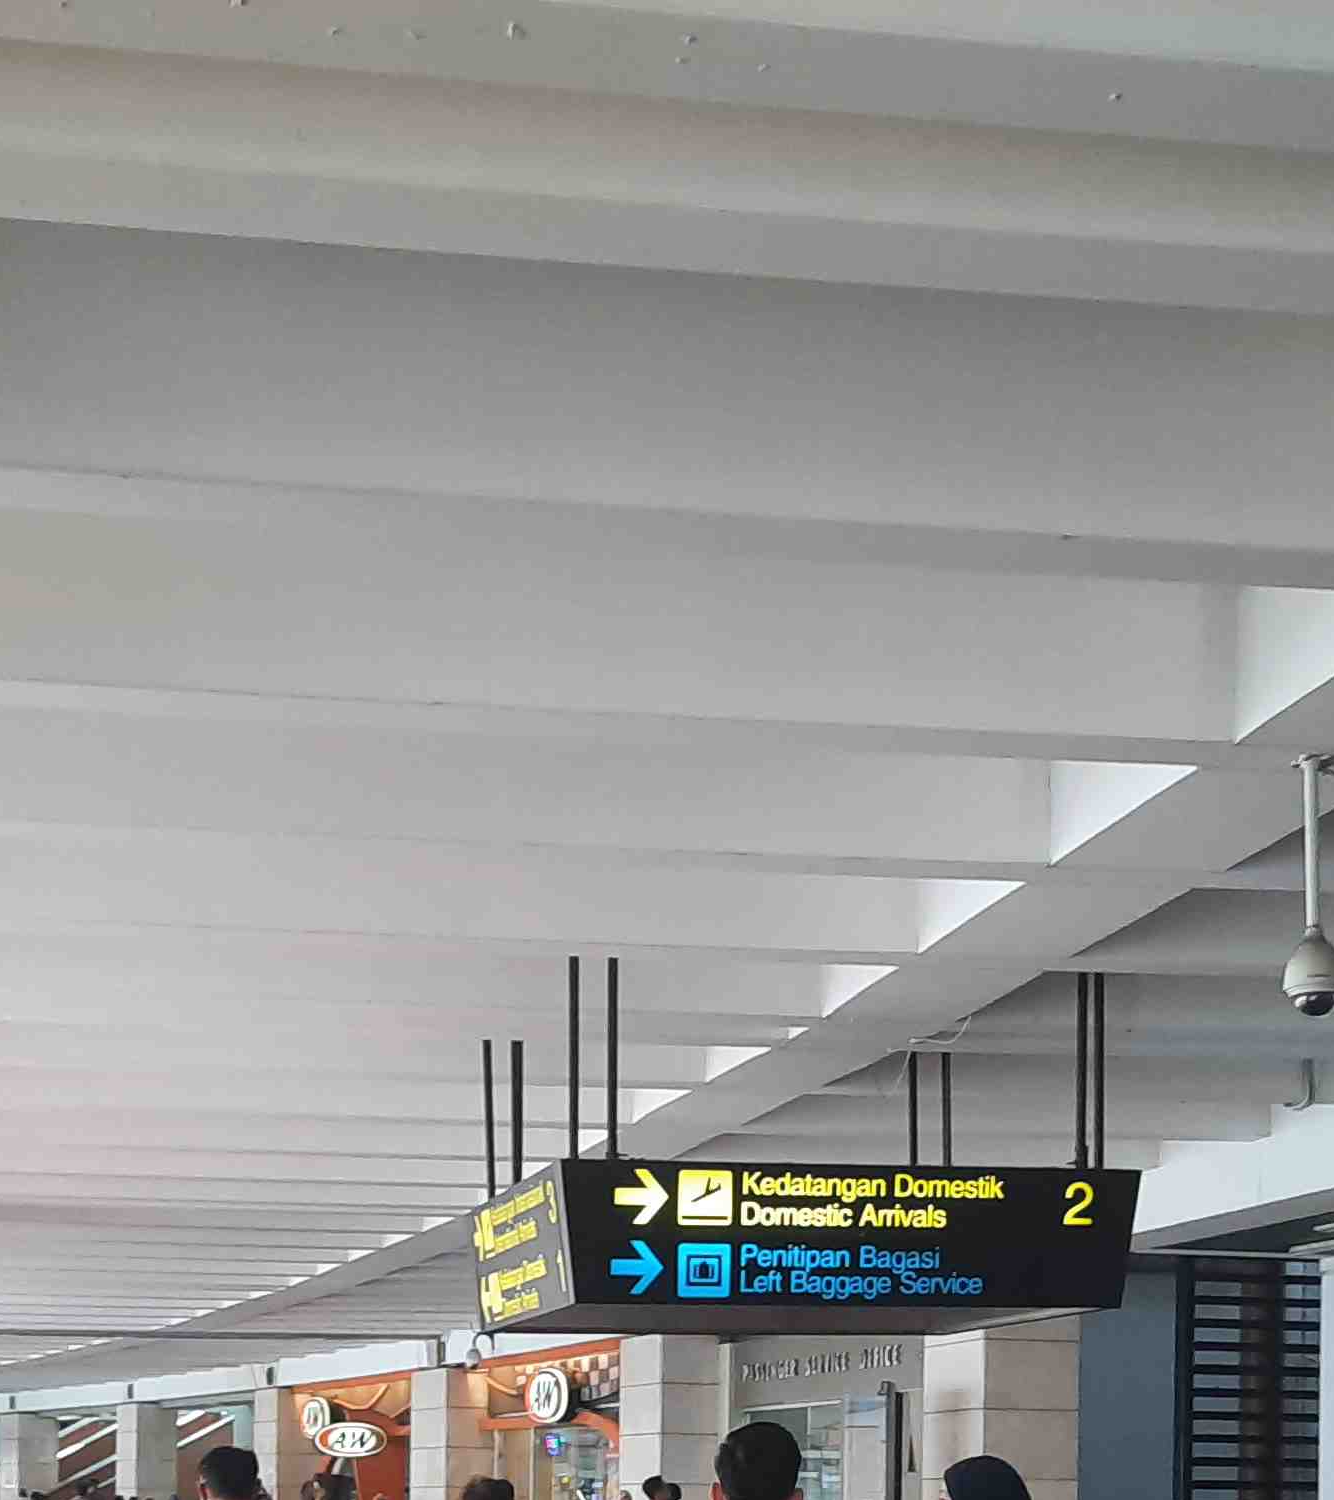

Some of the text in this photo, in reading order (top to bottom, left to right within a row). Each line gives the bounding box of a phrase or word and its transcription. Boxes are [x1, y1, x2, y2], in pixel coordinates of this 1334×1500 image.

[741, 1171, 1005, 1202] Kedatangan Domestik
[545, 1180, 557, 1224] 3
[740, 1201, 948, 1229] Domestic Arrivals
[1062, 1181, 1093, 1225] 2
[740, 1244, 941, 1274] Penitipan Bagasi
[739, 1271, 984, 1299] Left Baggage Service
